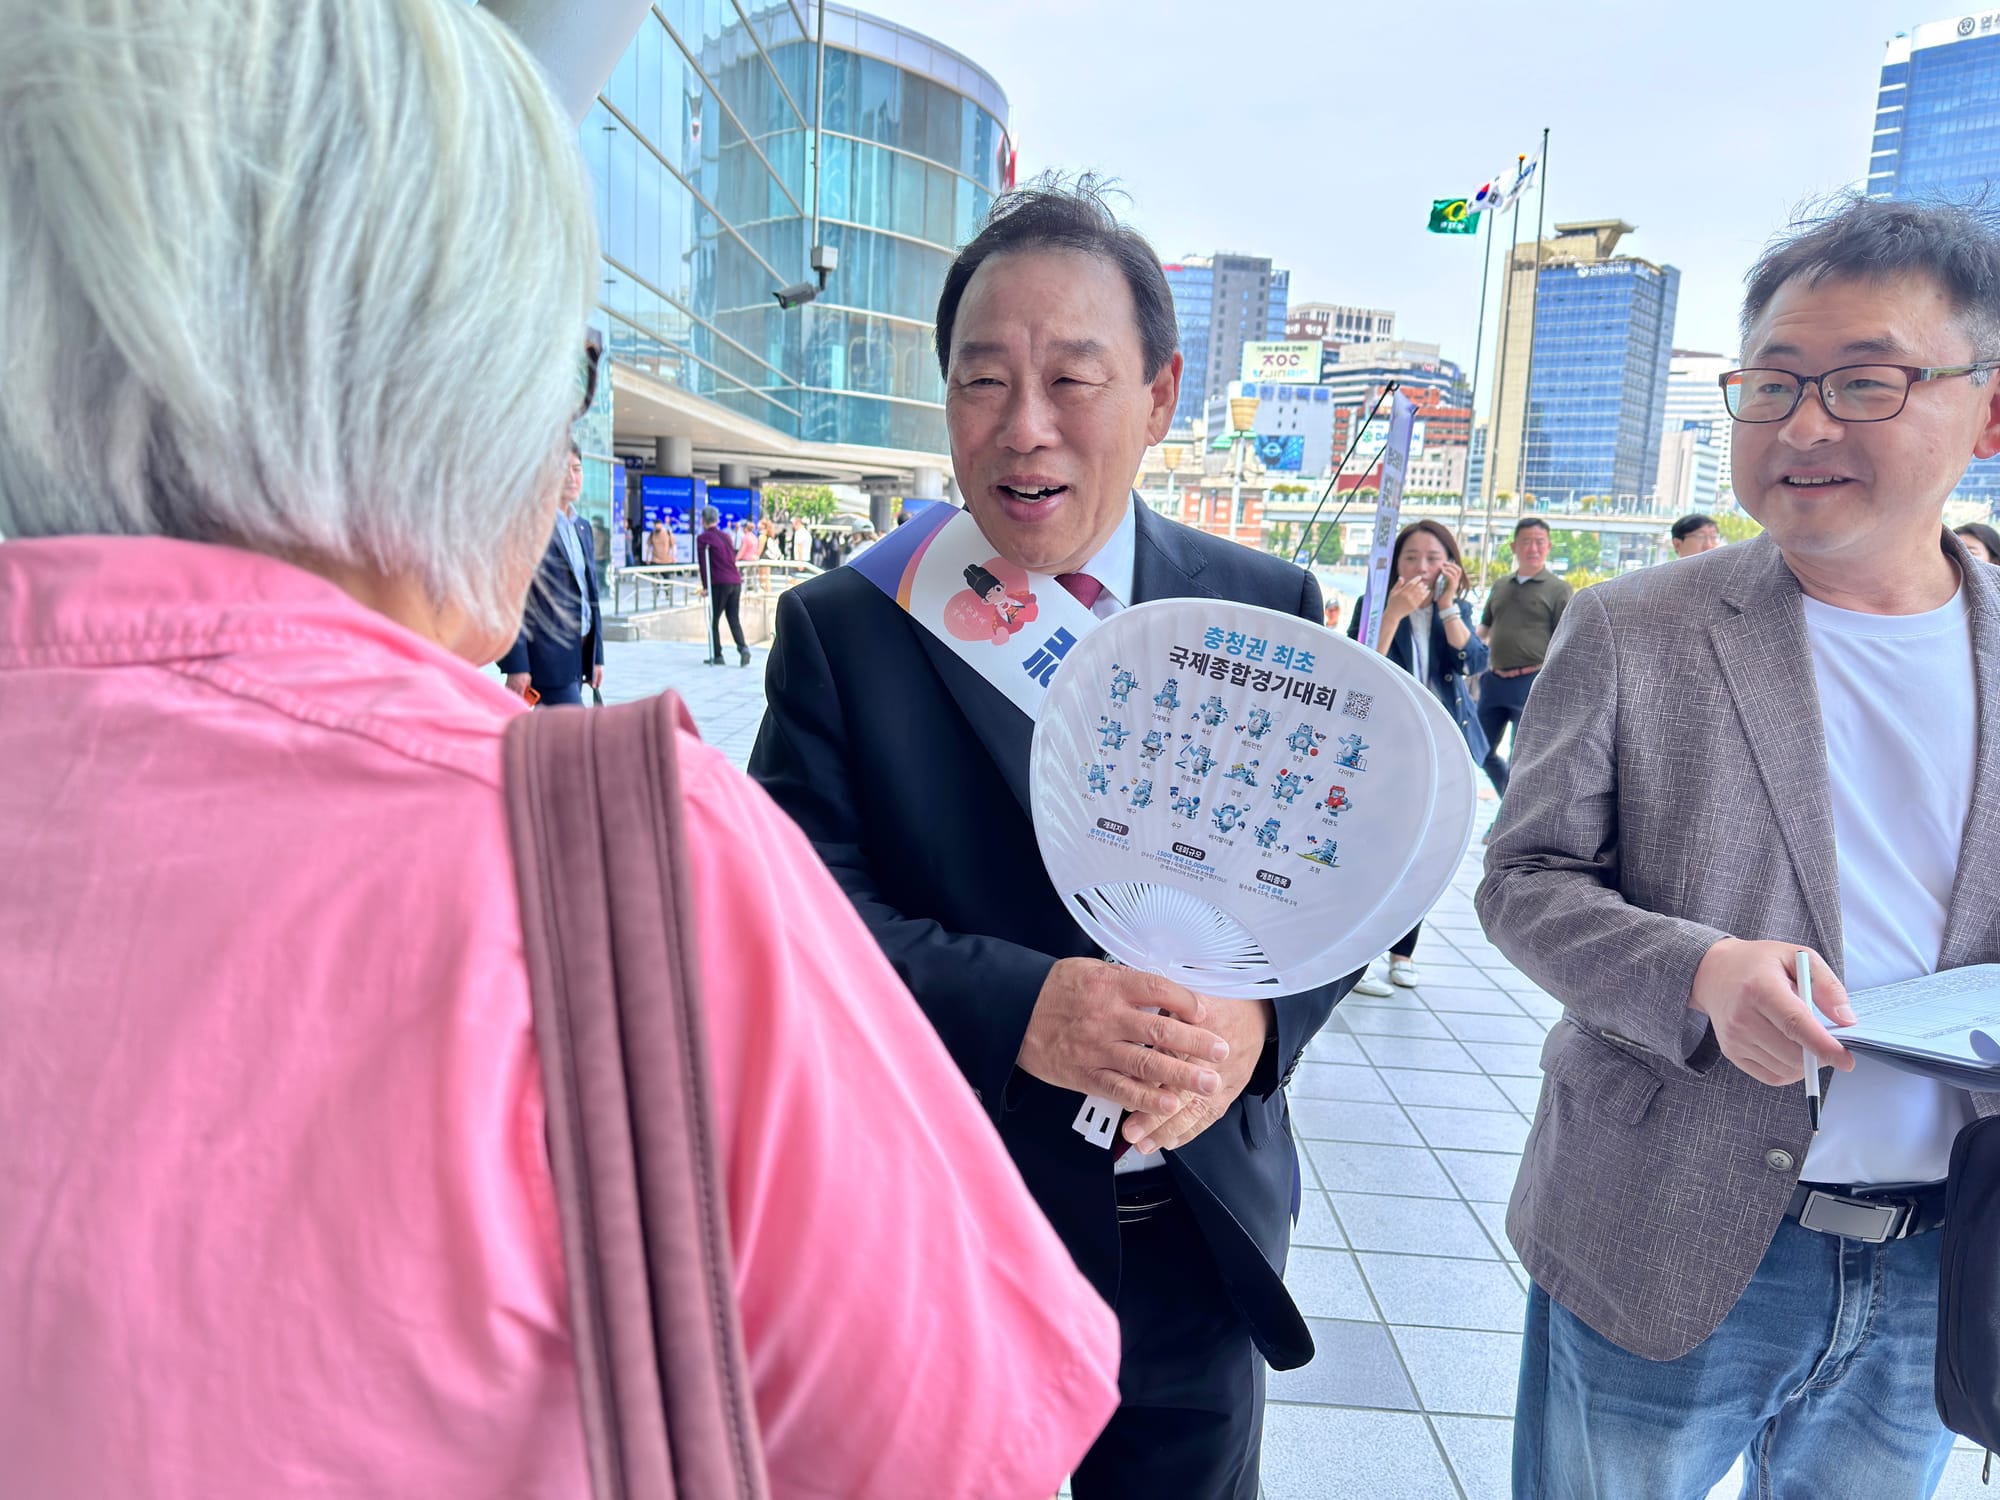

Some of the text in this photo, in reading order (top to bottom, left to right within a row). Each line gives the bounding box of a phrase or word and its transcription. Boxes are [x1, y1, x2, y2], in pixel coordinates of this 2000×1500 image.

[1204, 626, 1316, 673] 충청권 최초
[1169, 645, 1337, 711] 국제종합경기대회
[1241, 740, 1262, 751] 배드민턴
[1338, 768, 1355, 778] 다이빙
[1277, 803, 1287, 811] 탁구
[1103, 821, 1123, 833] 개최지
[1322, 817, 1338, 827] 태권도
[1208, 834, 1234, 847] 비치발리볼
[1175, 844, 1202, 858] 대회규모
[1260, 871, 1288, 887] 개최종목
